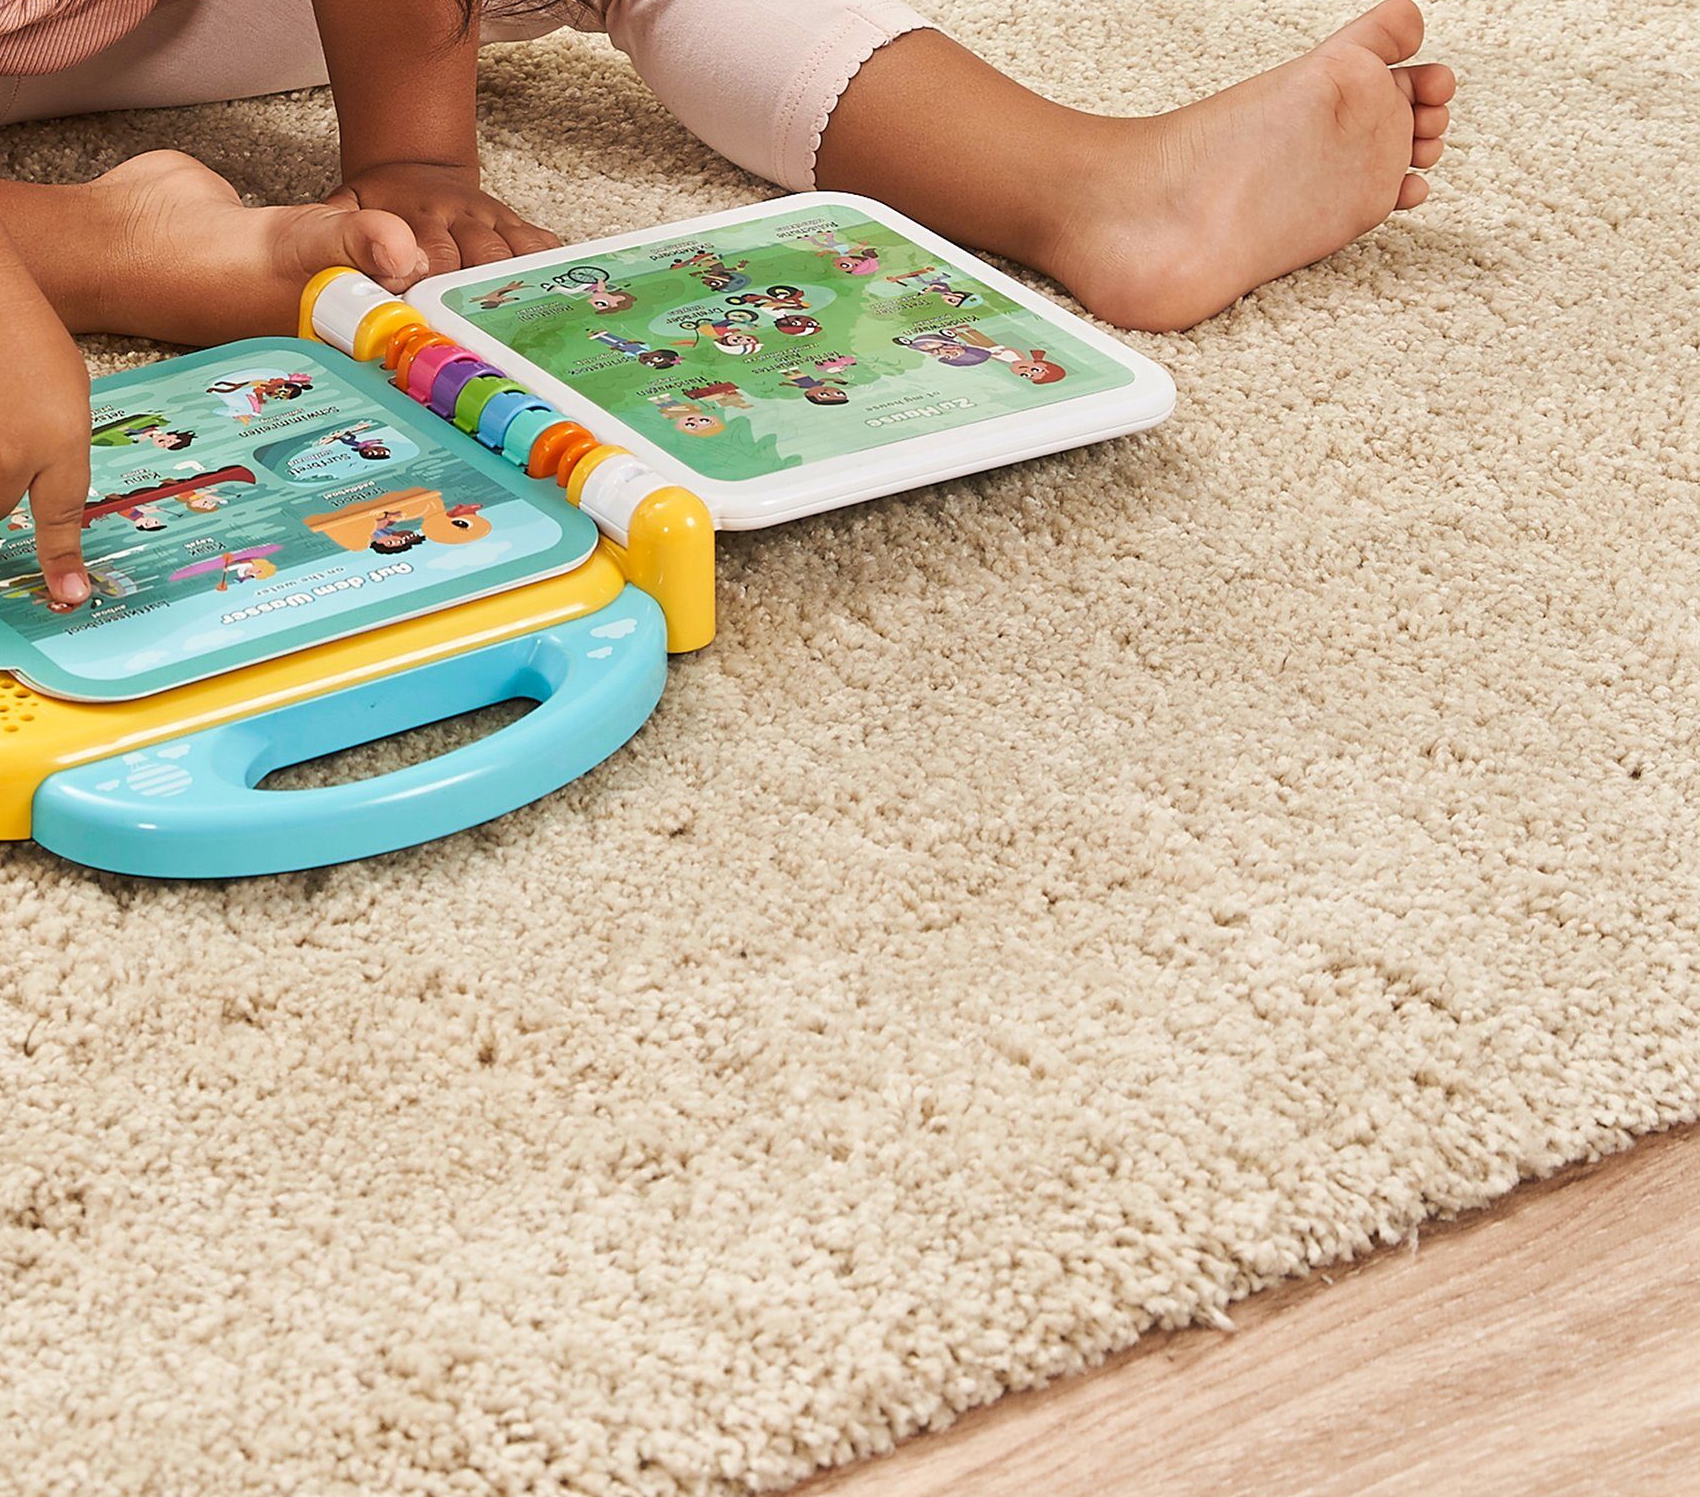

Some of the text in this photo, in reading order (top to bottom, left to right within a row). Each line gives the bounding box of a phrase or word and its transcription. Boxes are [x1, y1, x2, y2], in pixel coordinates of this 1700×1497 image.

[936, 397, 978, 411] Zu
[91, 409, 125, 423] Jetsk
[286, 453, 351, 478] Surfbrett
[123, 472, 161, 487] Kanu
[330, 487, 389, 508] Tretboot
[187, 543, 227, 557] Kajak
[253, 566, 345, 597] on the water
[220, 562, 414, 626] Auf dem Wasser
[64, 600, 171, 636] Luftkissenboot
